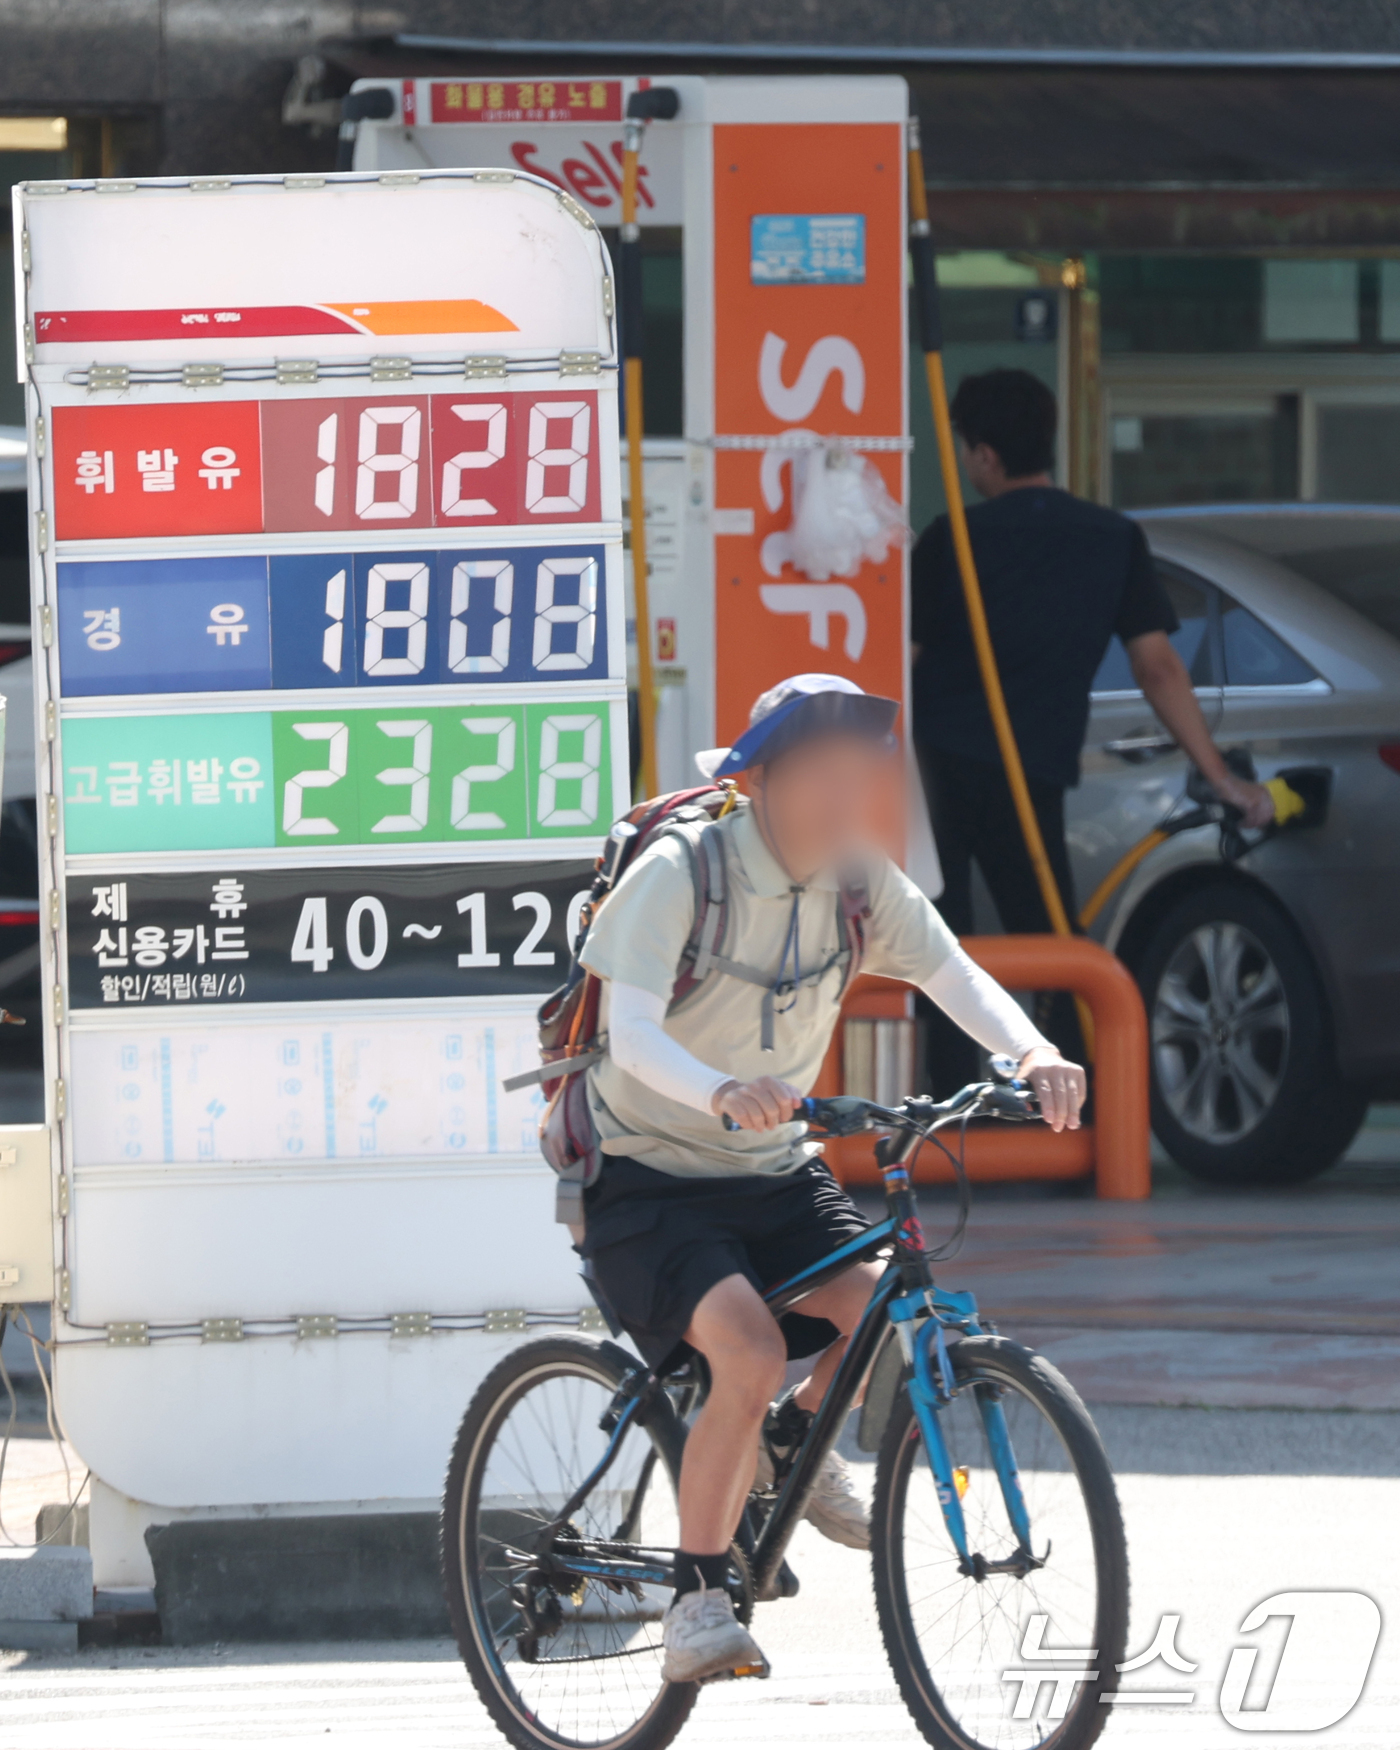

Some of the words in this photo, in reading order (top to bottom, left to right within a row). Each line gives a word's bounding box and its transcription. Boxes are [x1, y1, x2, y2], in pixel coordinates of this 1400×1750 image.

[516, 83, 556, 109] 경유
[75, 446, 241, 494] 휘발유
[314, 400, 592, 520] 1828
[322, 556, 599, 677] 1808
[66, 756, 265, 808] 고급휘발유
[282, 714, 602, 836] 2328
[92, 924, 249, 968] 신용카드
